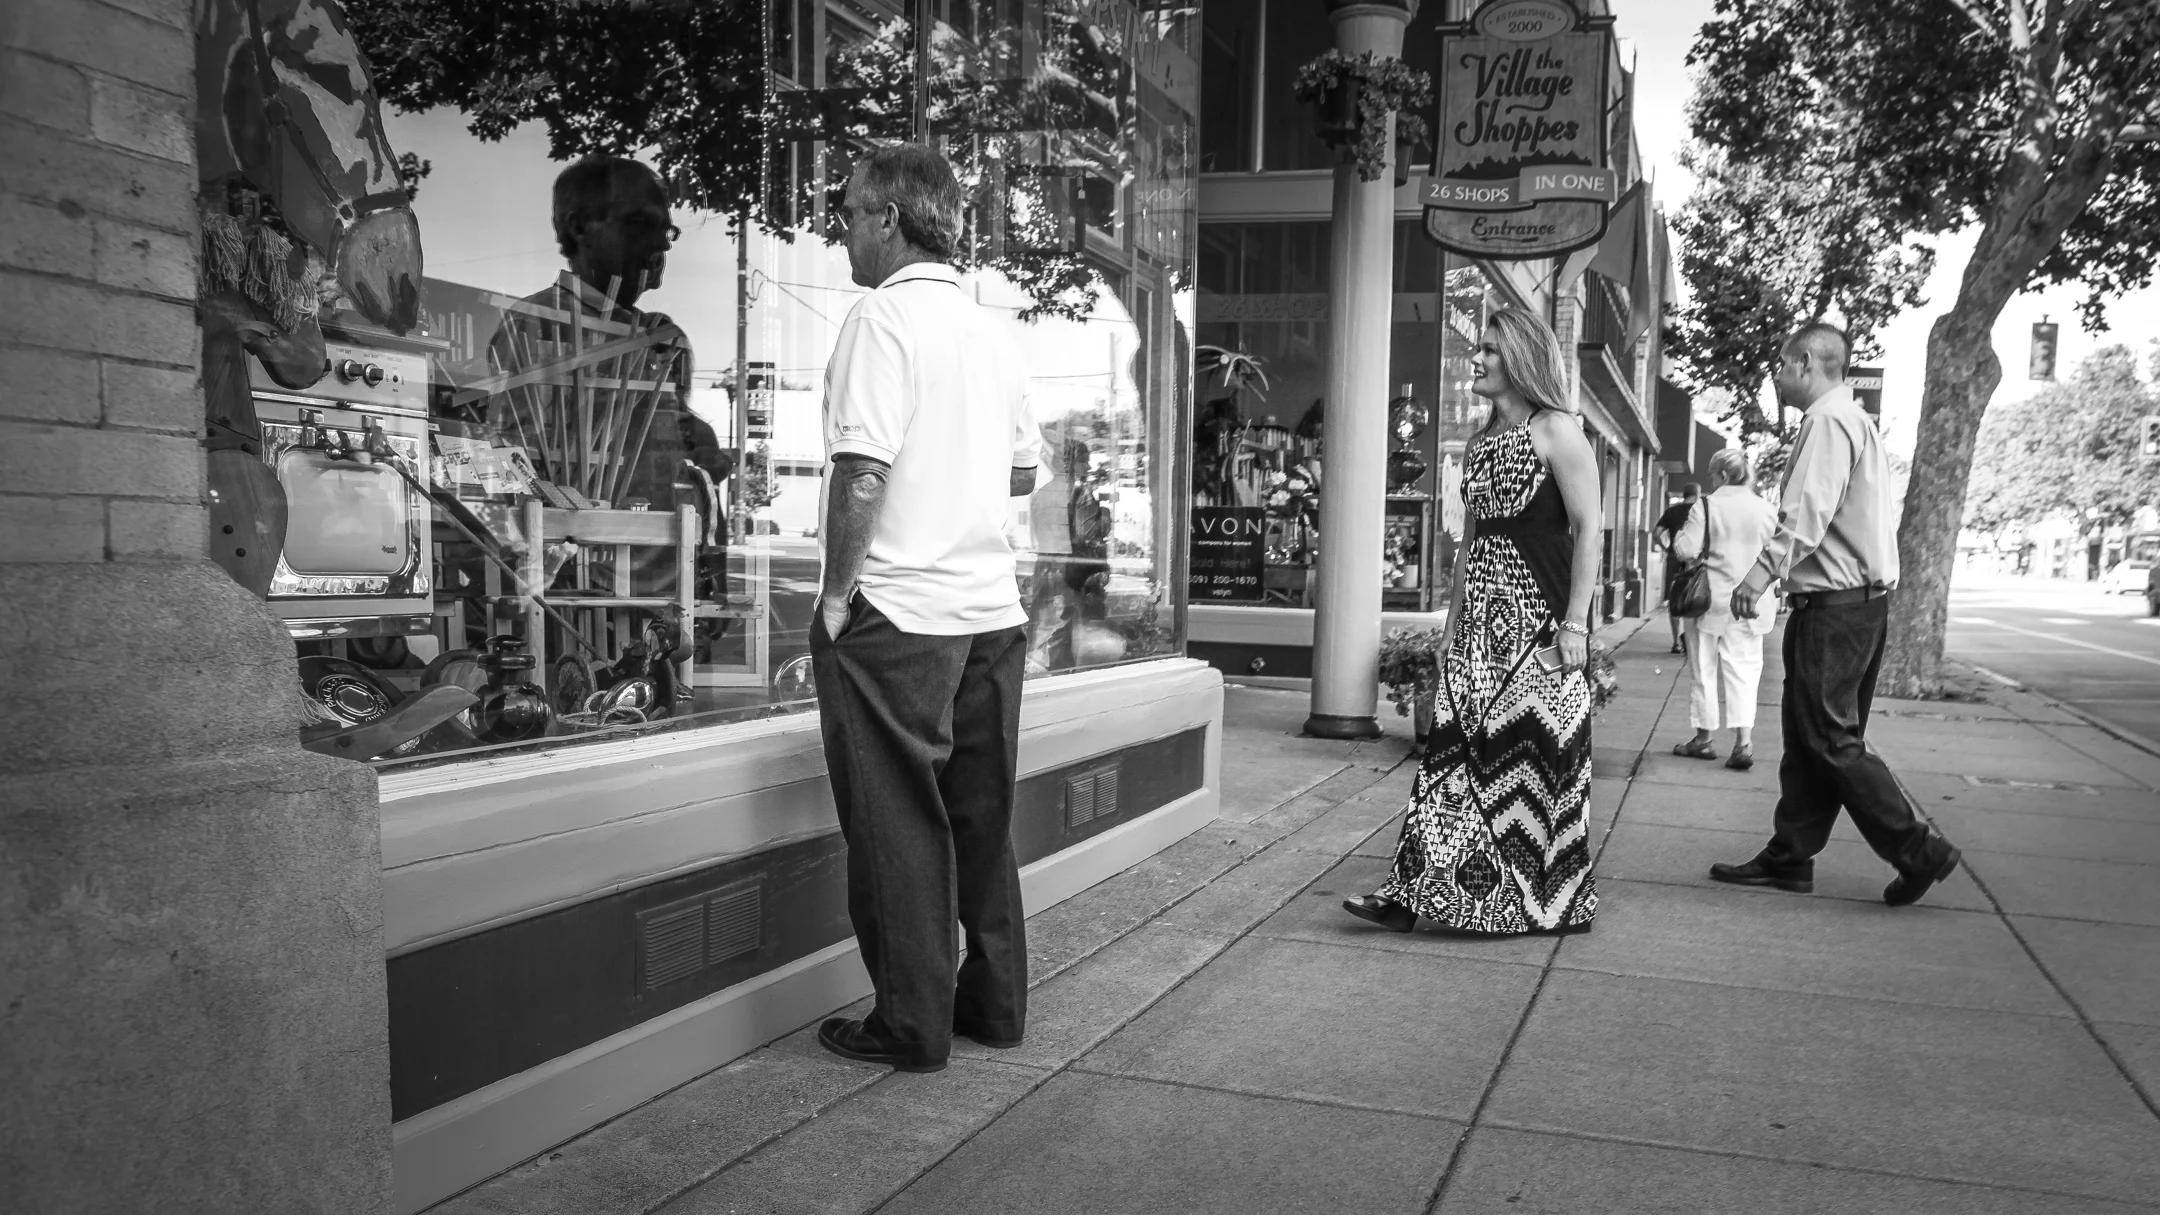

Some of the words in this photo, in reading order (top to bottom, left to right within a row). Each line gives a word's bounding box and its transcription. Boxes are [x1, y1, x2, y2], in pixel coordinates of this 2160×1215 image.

[1496, 8, 1556, 23] ESTABLISHED
[1507, 20, 1542, 33] 2000
[1536, 47, 1564, 69] the
[1460, 48, 1574, 114] Village
[1454, 99, 1580, 152] Shoppes
[1535, 174, 1556, 190] IN
[1562, 174, 1605, 192] ONE
[1430, 184, 1450, 199] 26
[1455, 186, 1510, 202] SHOPS
[1471, 217, 1556, 237] Entrance
